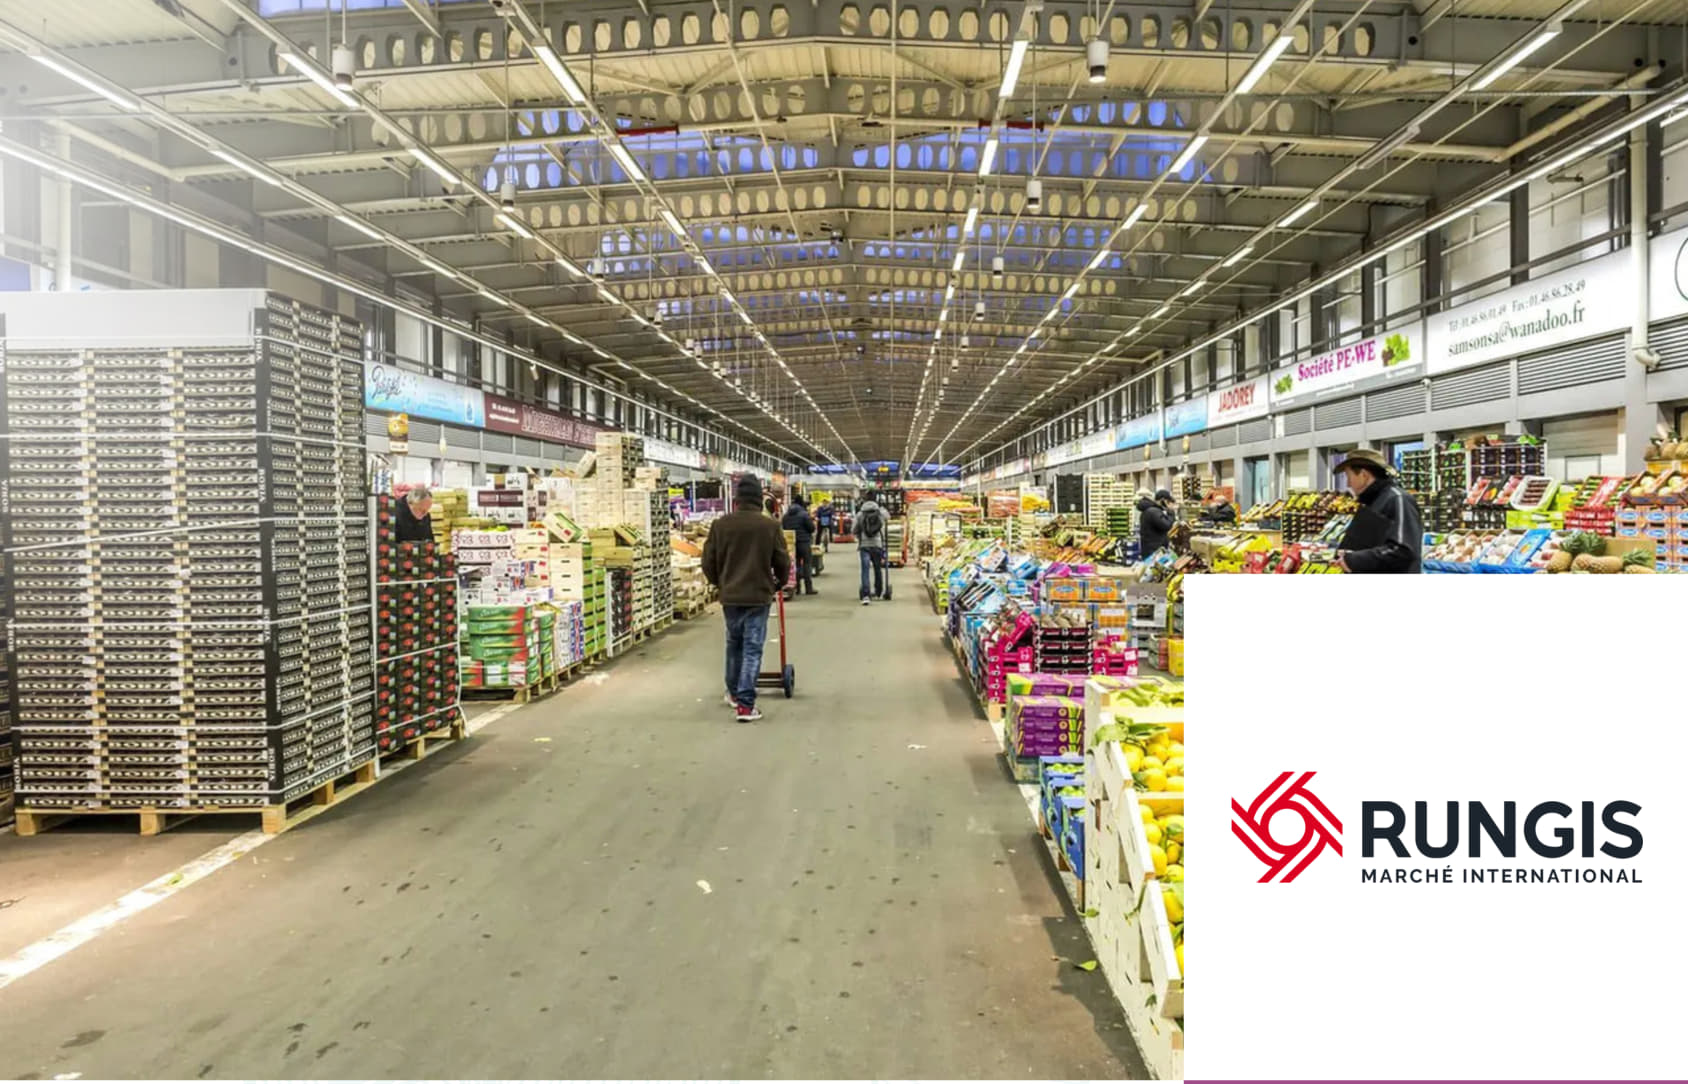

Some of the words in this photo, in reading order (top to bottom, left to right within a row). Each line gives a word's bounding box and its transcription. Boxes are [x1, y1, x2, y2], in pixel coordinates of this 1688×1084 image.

[1448, 300, 1586, 356] samsonsa@wanadoo.fr
[1298, 354, 1333, 381] Société
[1336, 340, 1376, 370] PE-WE
[1218, 382, 1256, 412] JADOREY
